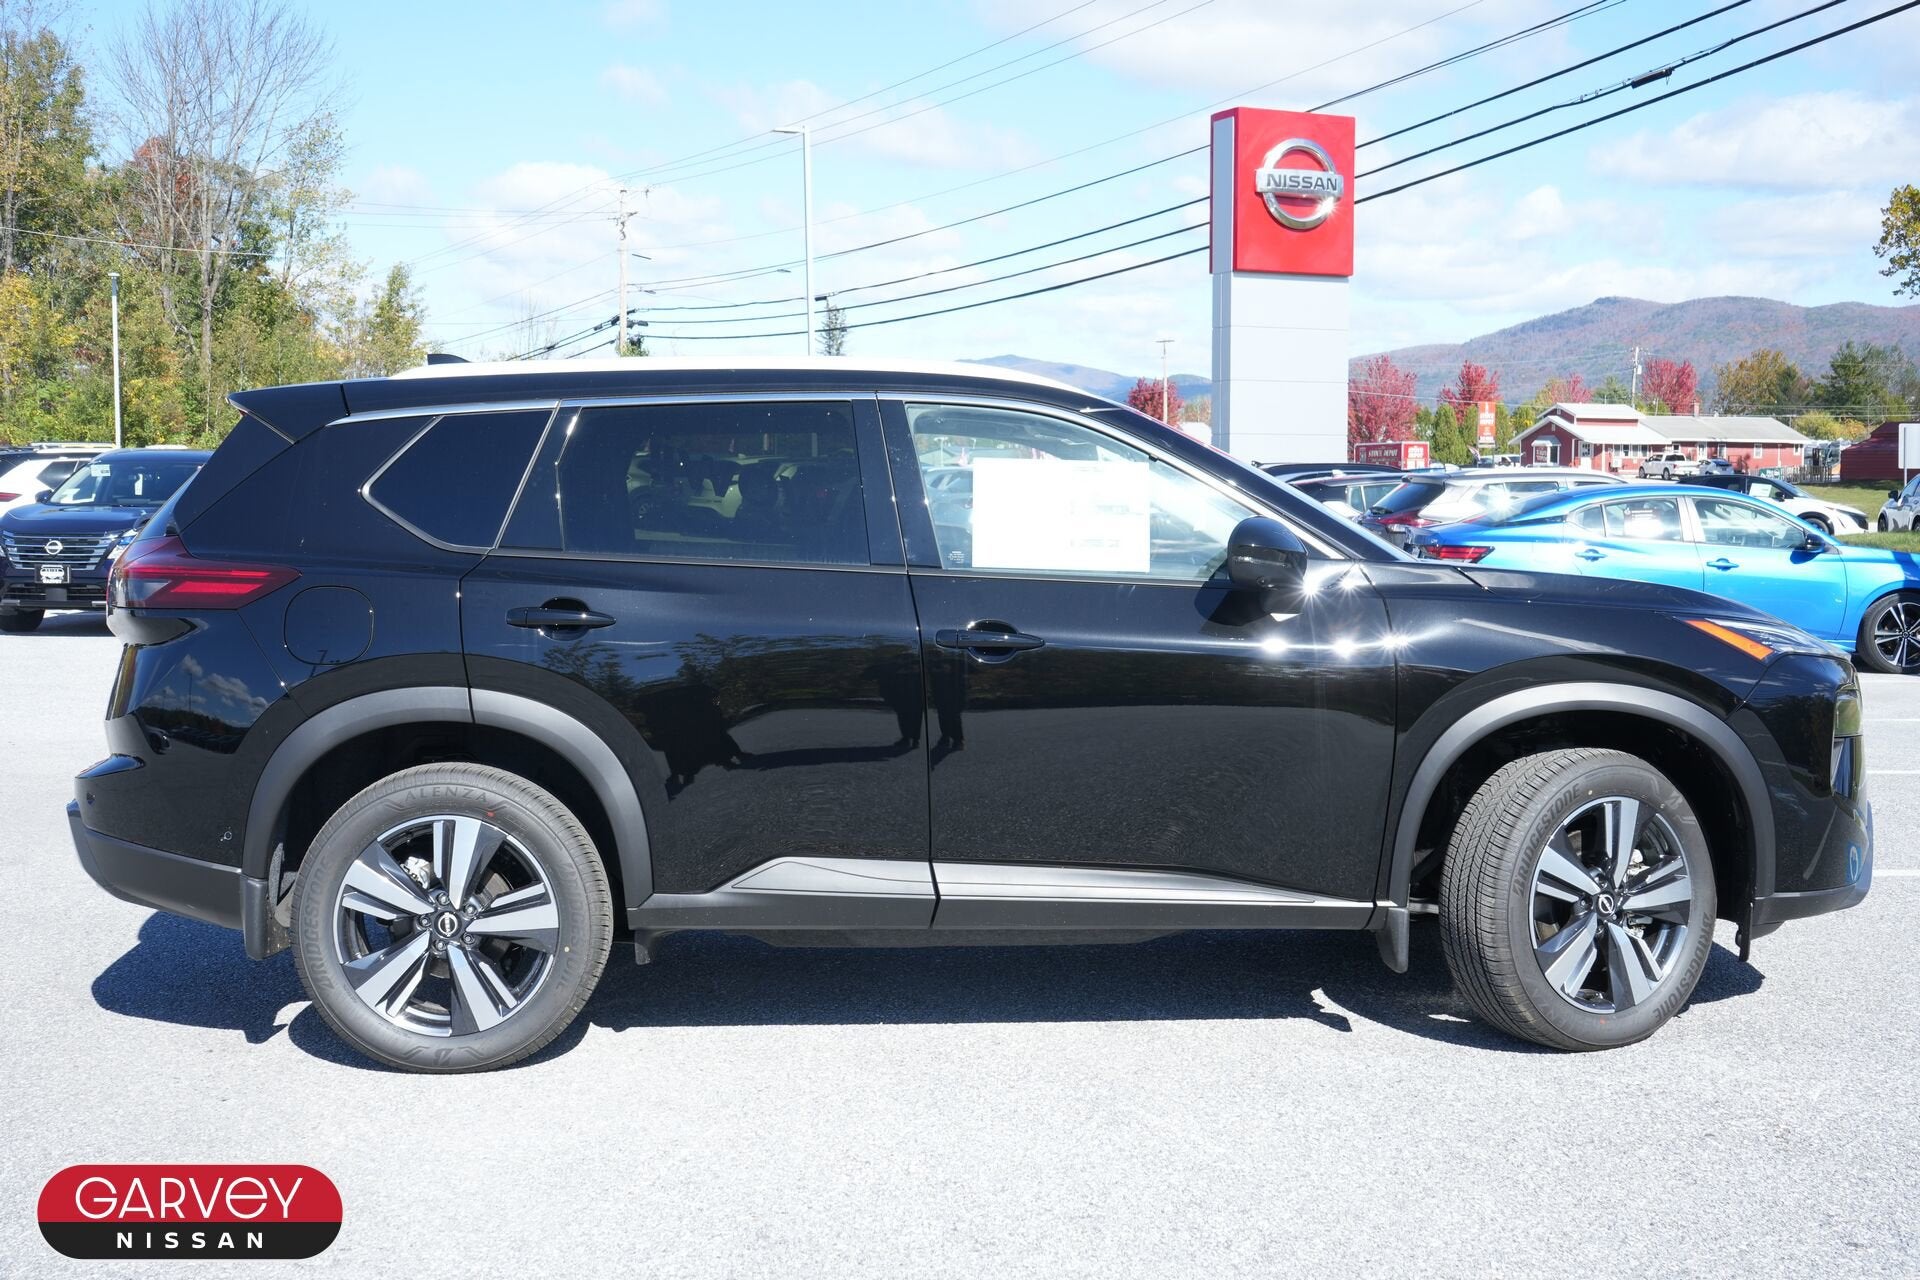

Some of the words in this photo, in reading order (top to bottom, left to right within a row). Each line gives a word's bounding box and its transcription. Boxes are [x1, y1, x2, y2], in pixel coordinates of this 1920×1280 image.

[1266, 173, 1338, 191] NISSAN
[404, 786, 487, 802] ALENZA
[1511, 783, 1580, 897] BRIDGESTONE
[303, 855, 335, 990] BRIDGESTONE
[1653, 912, 1713, 1020] BRIDGESTONE
